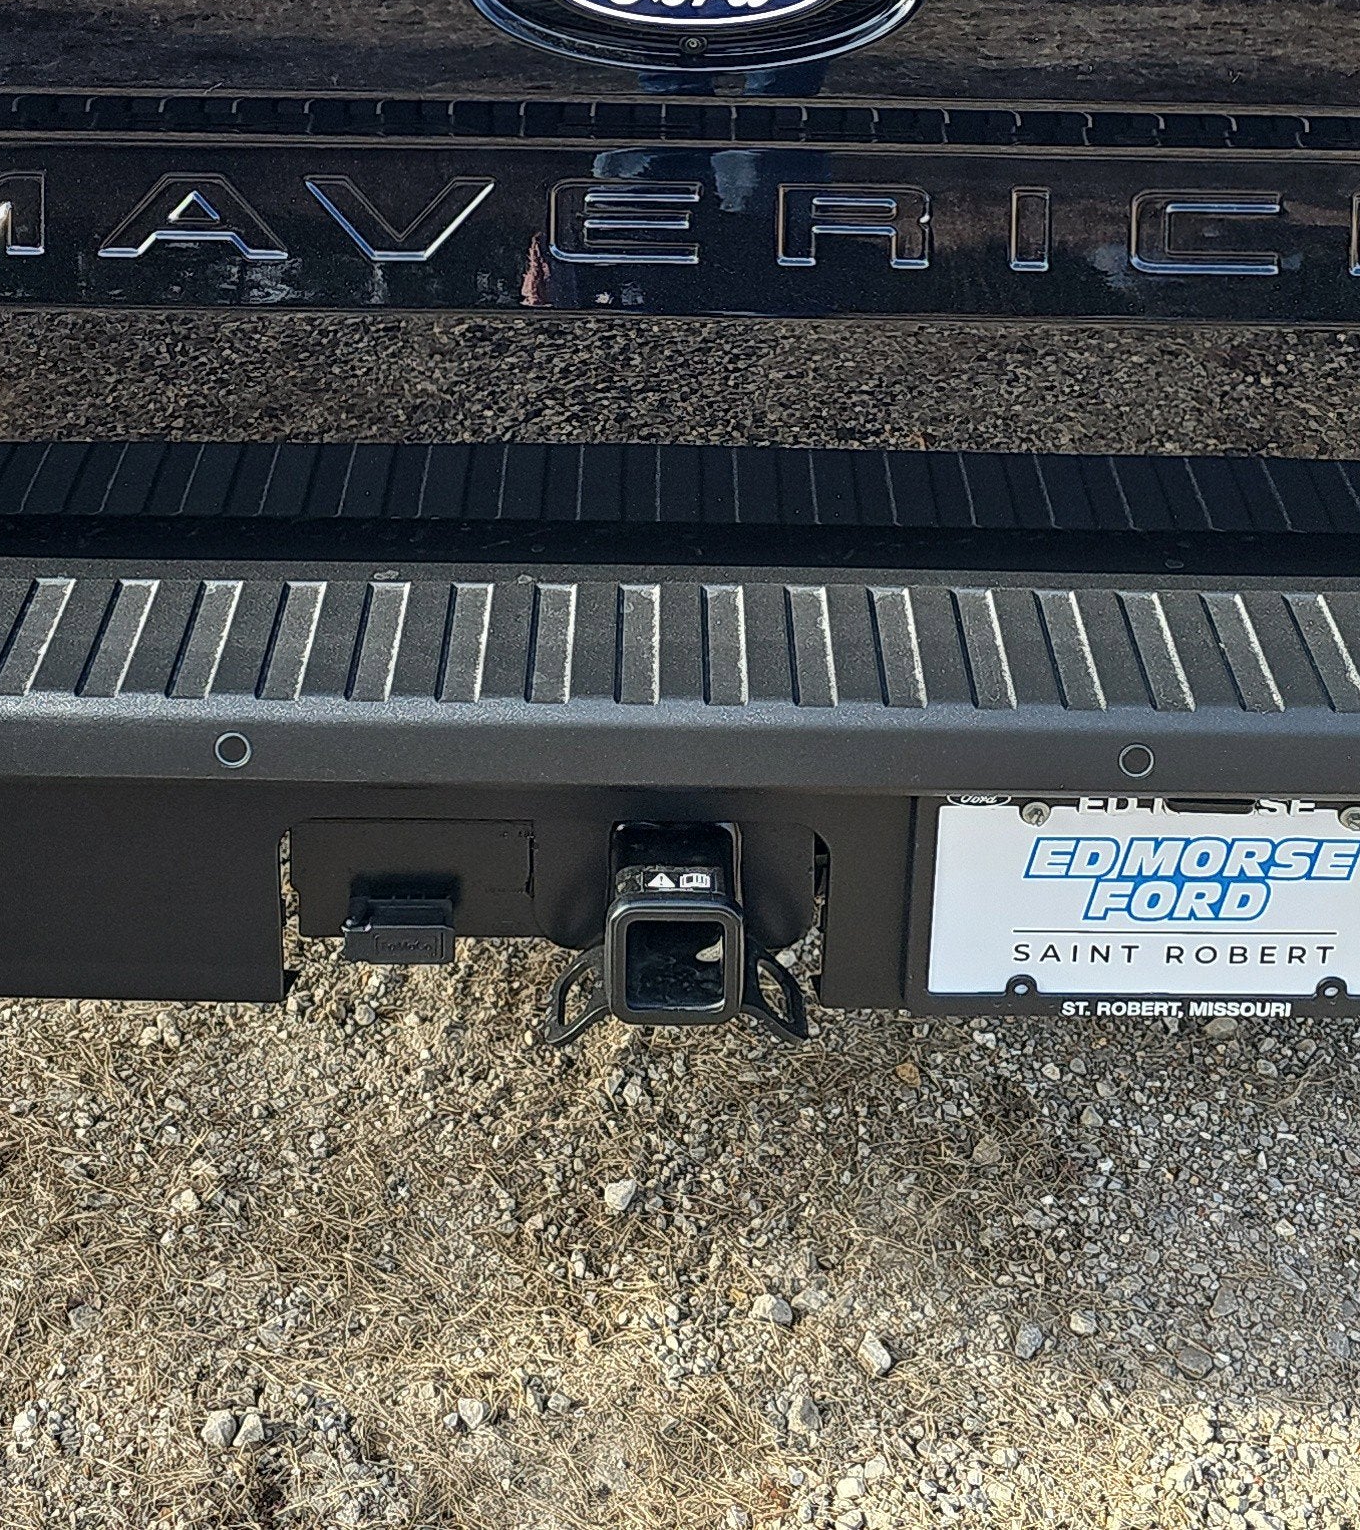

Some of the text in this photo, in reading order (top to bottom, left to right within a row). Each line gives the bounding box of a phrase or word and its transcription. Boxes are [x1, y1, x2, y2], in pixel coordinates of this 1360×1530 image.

[1023, 837, 1121, 879] ED
[1082, 878, 1272, 921] FORD
[1013, 943, 1335, 964] SAINT ROBERT
[1061, 1001, 1292, 1018] ST. ROBERT, MISSOURI
